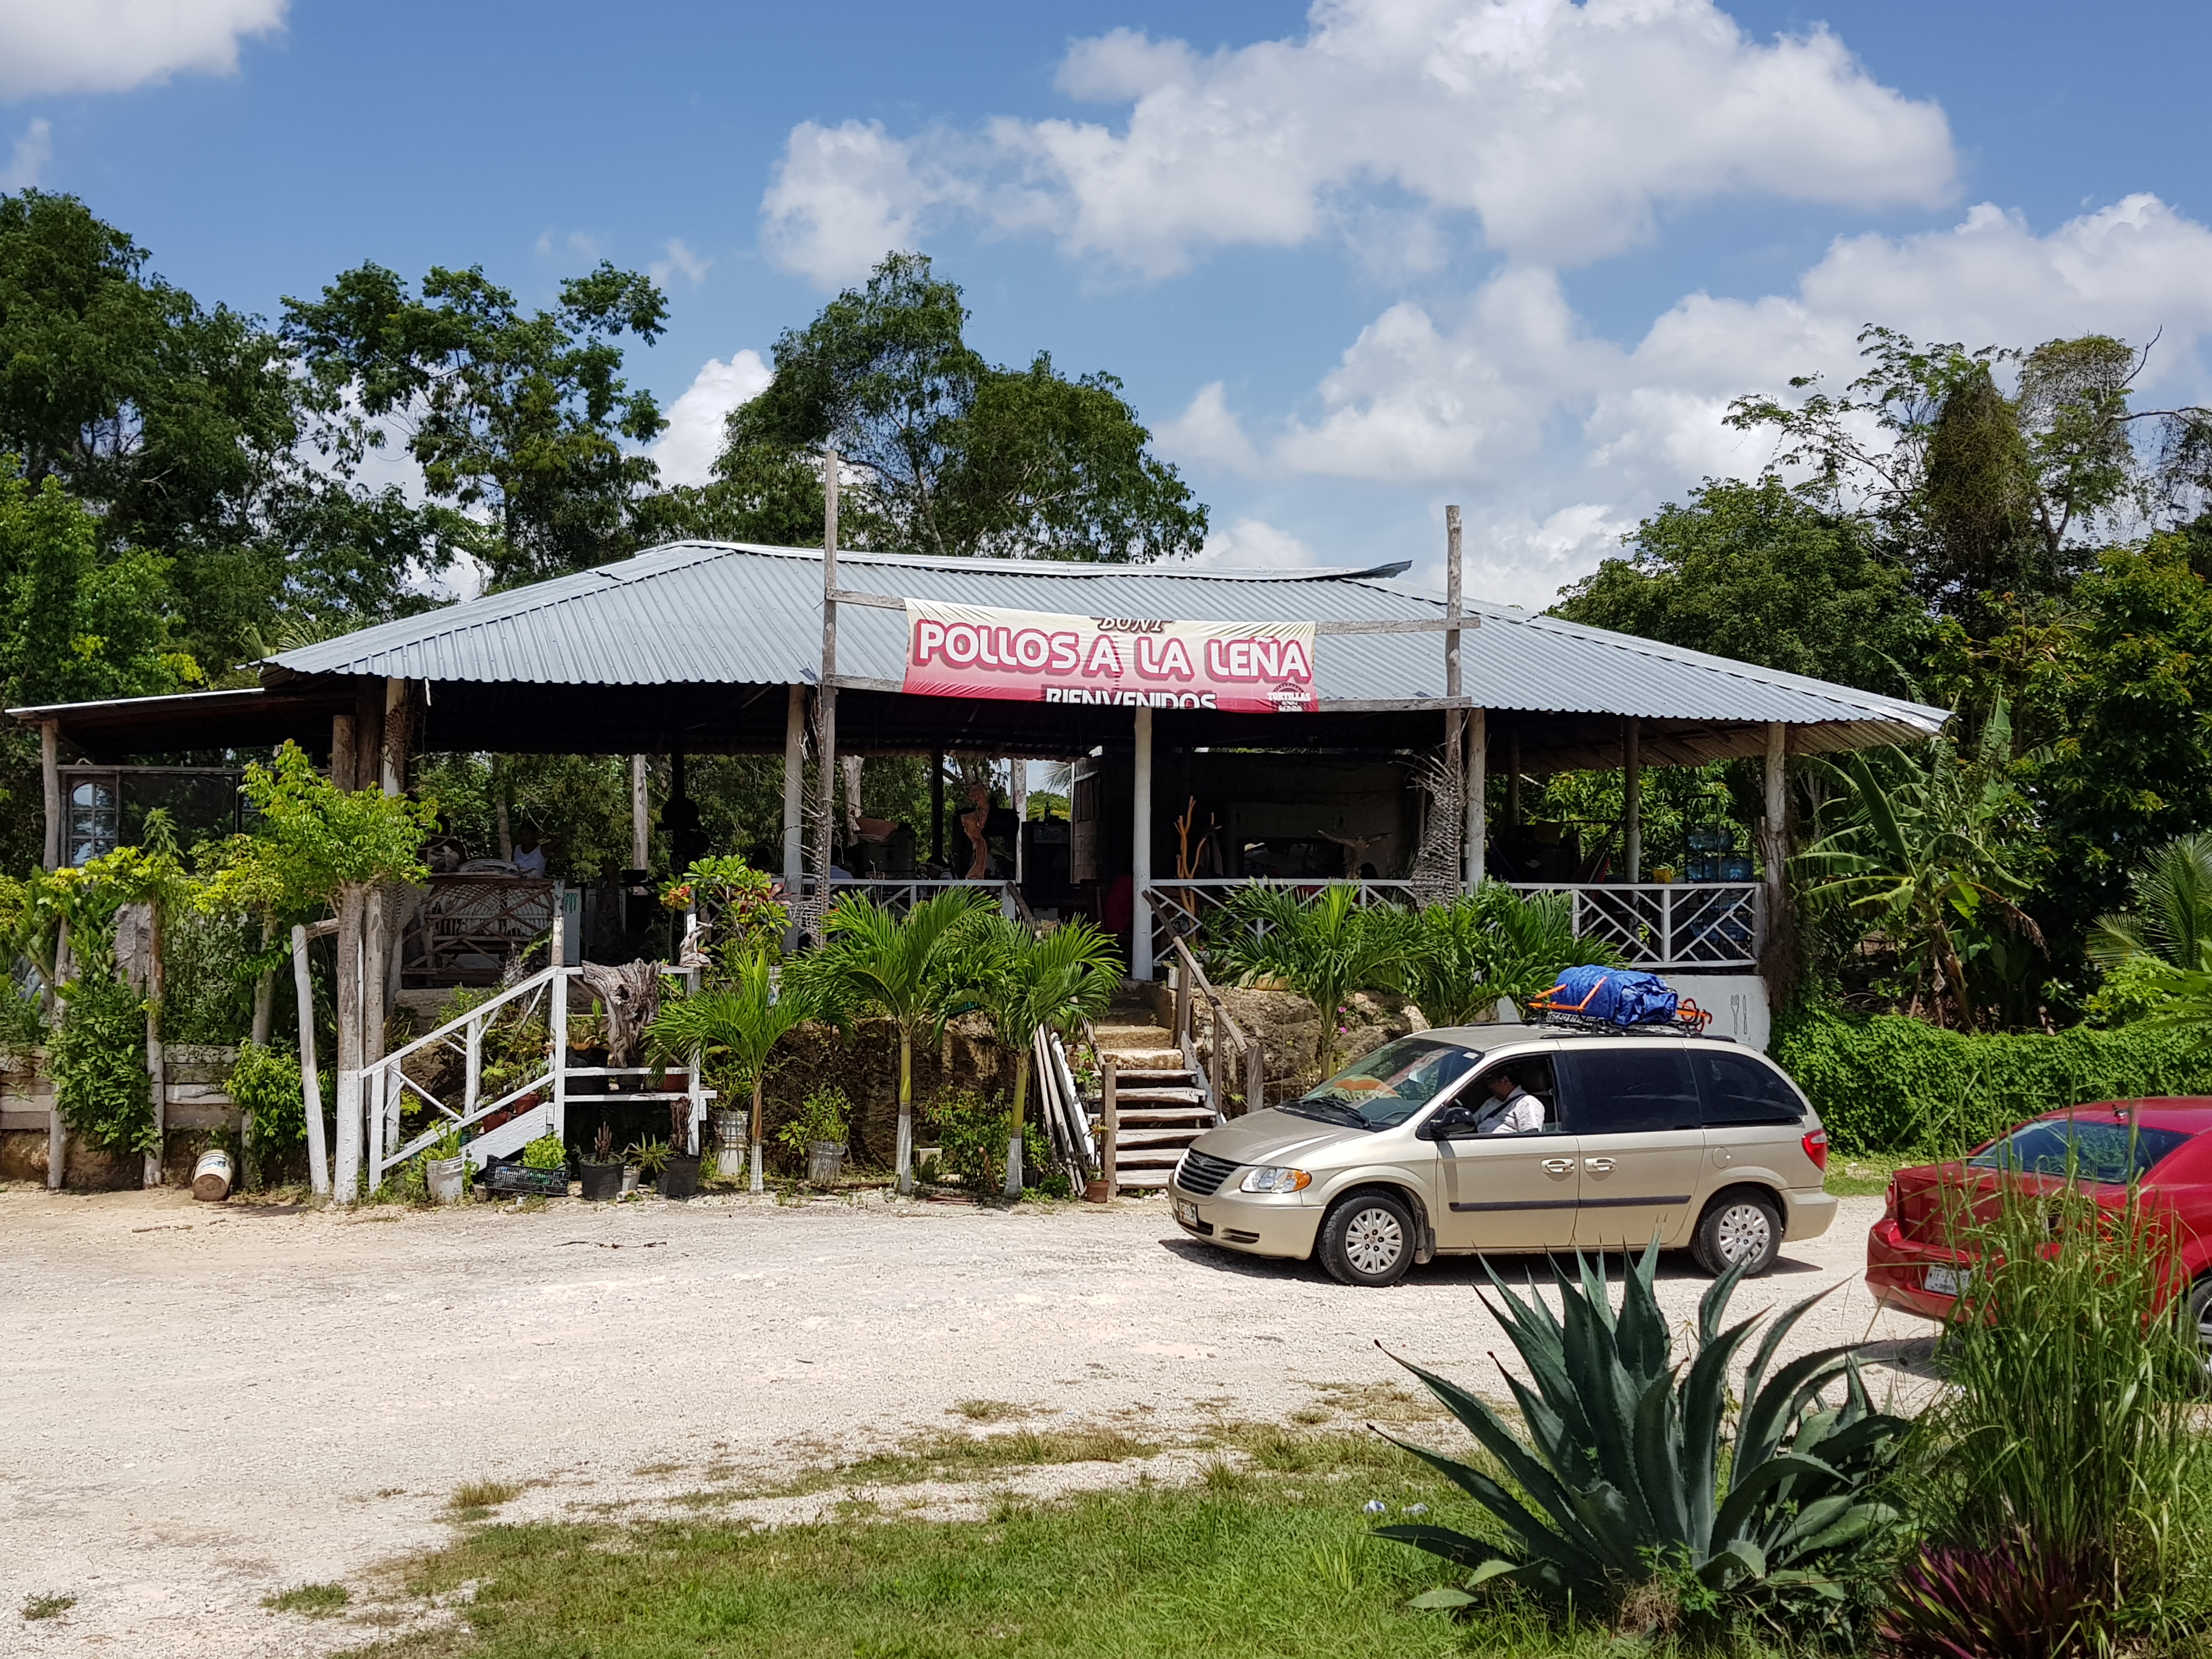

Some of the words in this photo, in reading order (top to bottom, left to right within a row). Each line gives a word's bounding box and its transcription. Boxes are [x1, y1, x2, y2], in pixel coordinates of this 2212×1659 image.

[918, 620, 1079, 670] POLLOS
[1087, 636, 1122, 674] A
[1138, 638, 1193, 676] LA
[1209, 635, 1310, 678] LEÑA
[1267, 692, 1311, 702] TORTILLAS
